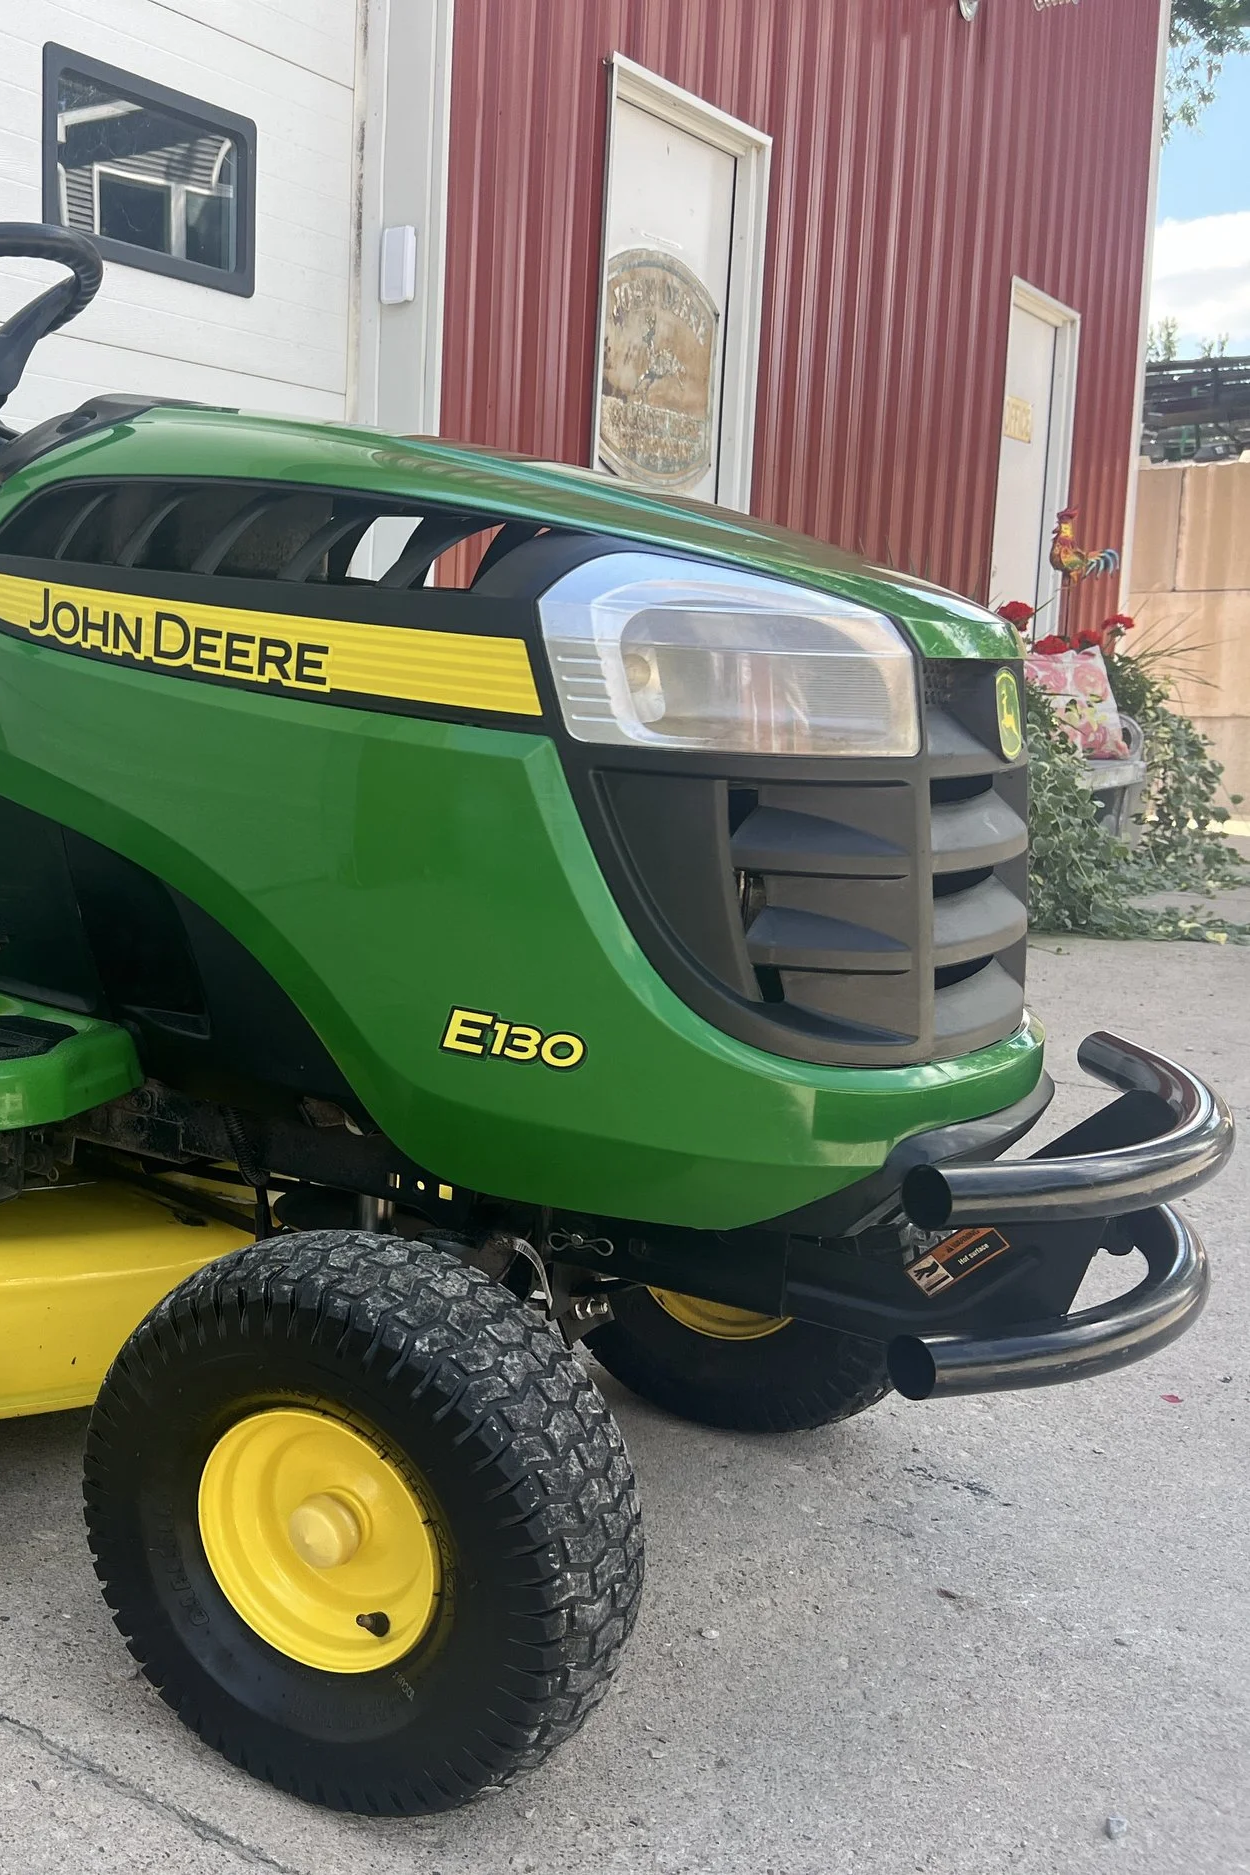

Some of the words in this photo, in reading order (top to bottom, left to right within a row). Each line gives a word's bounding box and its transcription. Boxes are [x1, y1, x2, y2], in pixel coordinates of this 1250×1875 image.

[30, 588, 143, 655] JOHN
[153, 611, 330, 687] DEERE
[441, 1007, 586, 1069] E130
[958, 1255, 970, 1266] Hot
[969, 1243, 990, 1259] surface
